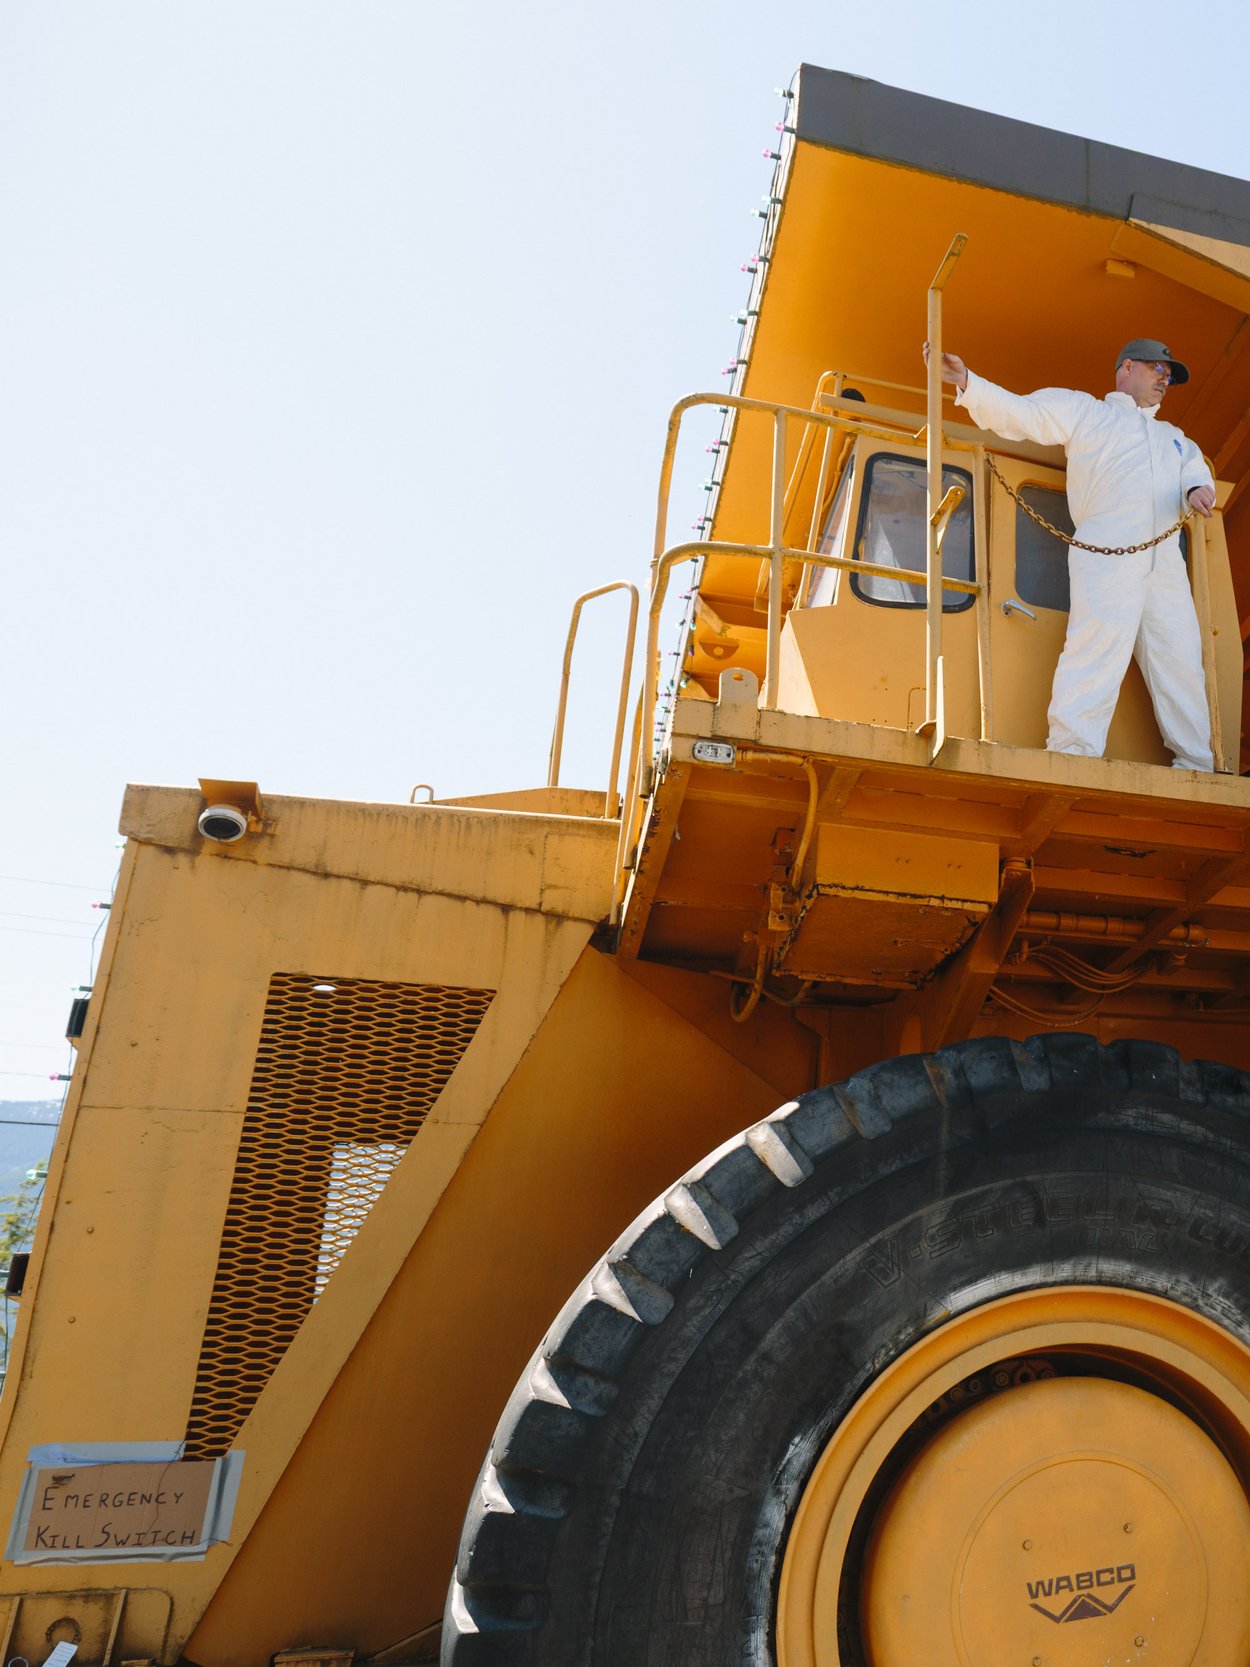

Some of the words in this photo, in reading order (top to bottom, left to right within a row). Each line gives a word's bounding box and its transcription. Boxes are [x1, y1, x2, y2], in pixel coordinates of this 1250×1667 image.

[42, 1486, 184, 1511] EMERGENCY
[35, 1525, 85, 1548] KILL
[94, 1522, 196, 1548] SWITCH
[1026, 1563, 1137, 1600] WABCO
